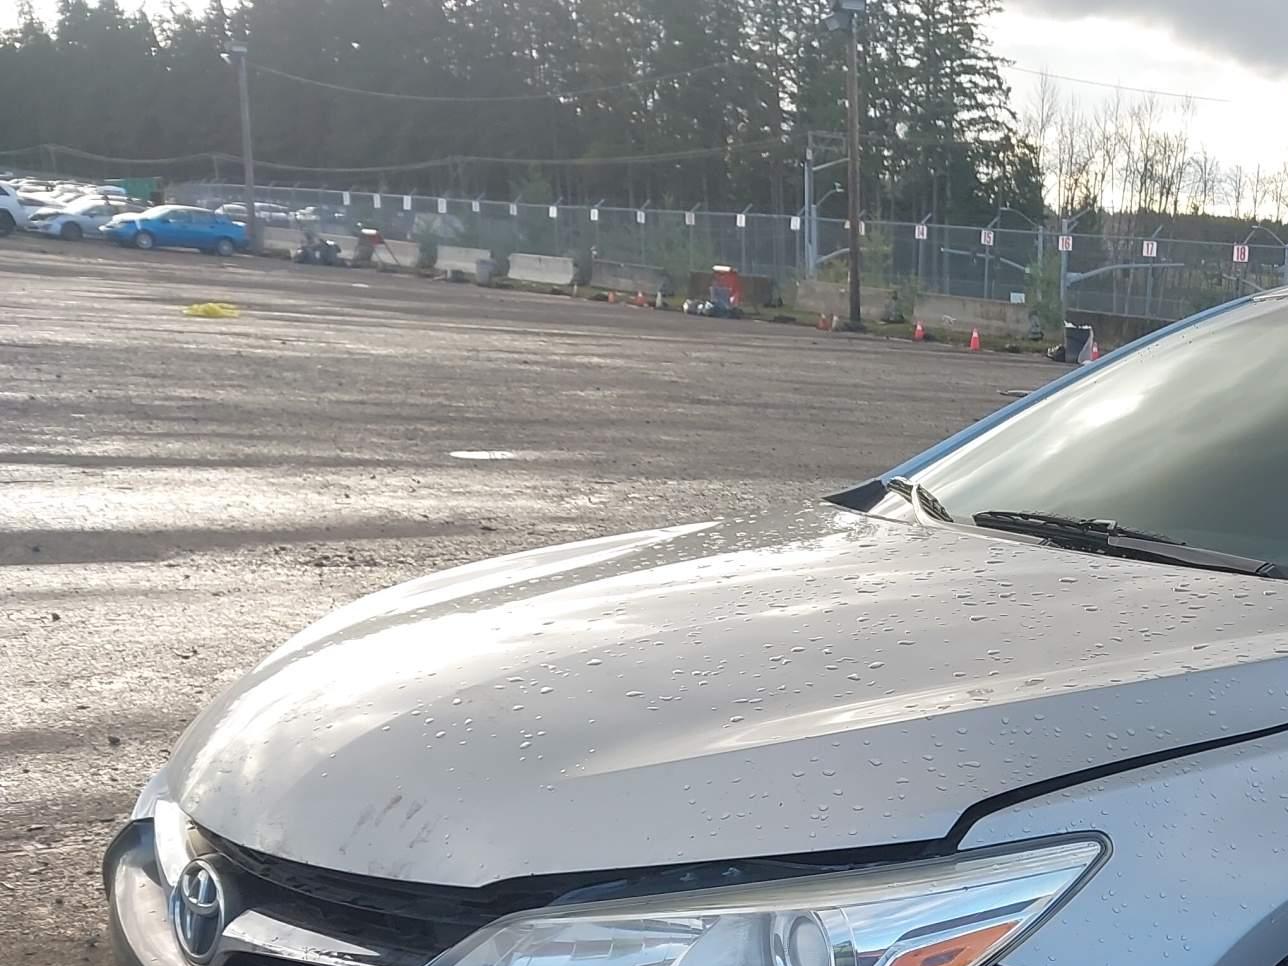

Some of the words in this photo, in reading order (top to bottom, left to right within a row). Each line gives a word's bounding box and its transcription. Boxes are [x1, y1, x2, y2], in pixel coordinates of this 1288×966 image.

[983, 231, 993, 246] 15
[1061, 236, 1072, 250] 16
[1146, 242, 1155, 256] 17
[1236, 246, 1246, 262] 18
